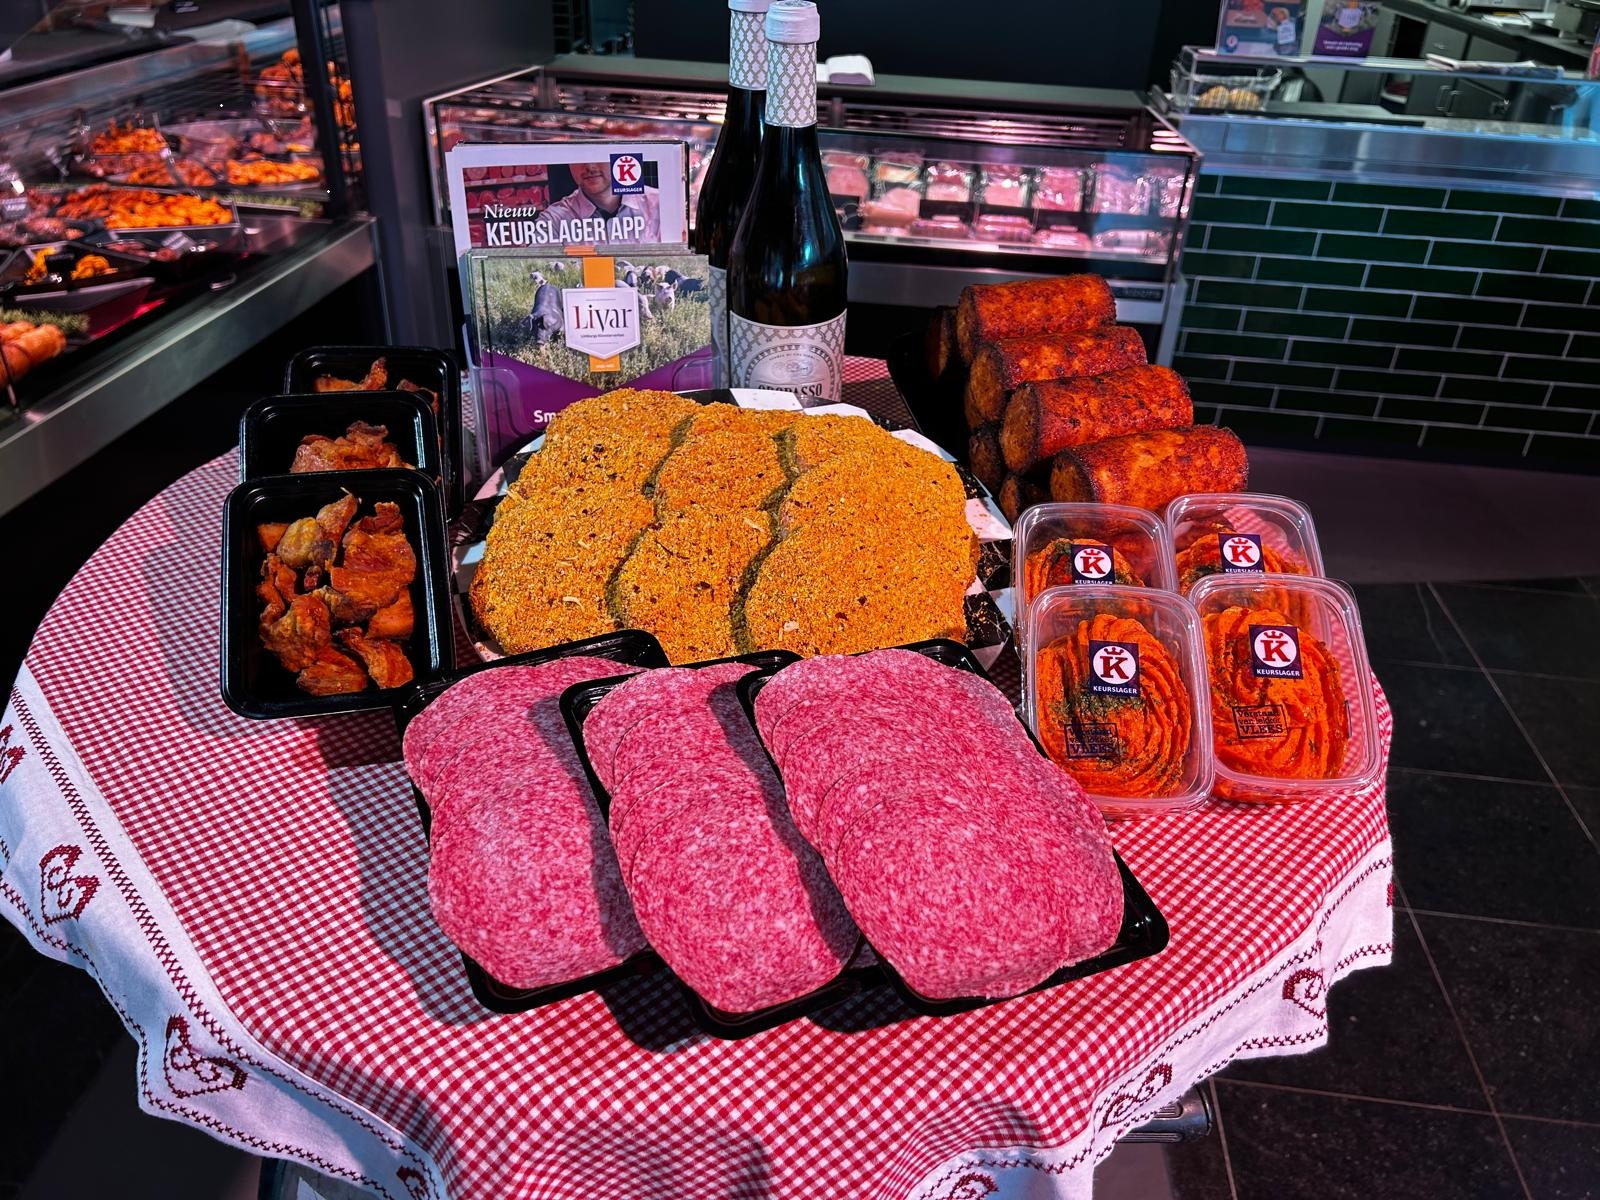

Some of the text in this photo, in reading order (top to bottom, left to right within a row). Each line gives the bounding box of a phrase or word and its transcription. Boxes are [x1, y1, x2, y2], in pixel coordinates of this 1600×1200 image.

[617, 164, 637, 182] K
[484, 204, 537, 219] Nieuw
[486, 216, 646, 247] KEURSLAGER APP
[572, 304, 632, 332] Livar
[1228, 545, 1256, 563] K
[1080, 556, 1106, 574] K
[1260, 639, 1291, 662] K
[1100, 655, 1129, 680] K
[1256, 668, 1301, 677] KEURSLAGER
[1093, 685, 1138, 694] KEURSLAGER
[1240, 724, 1284, 734] VLEES
